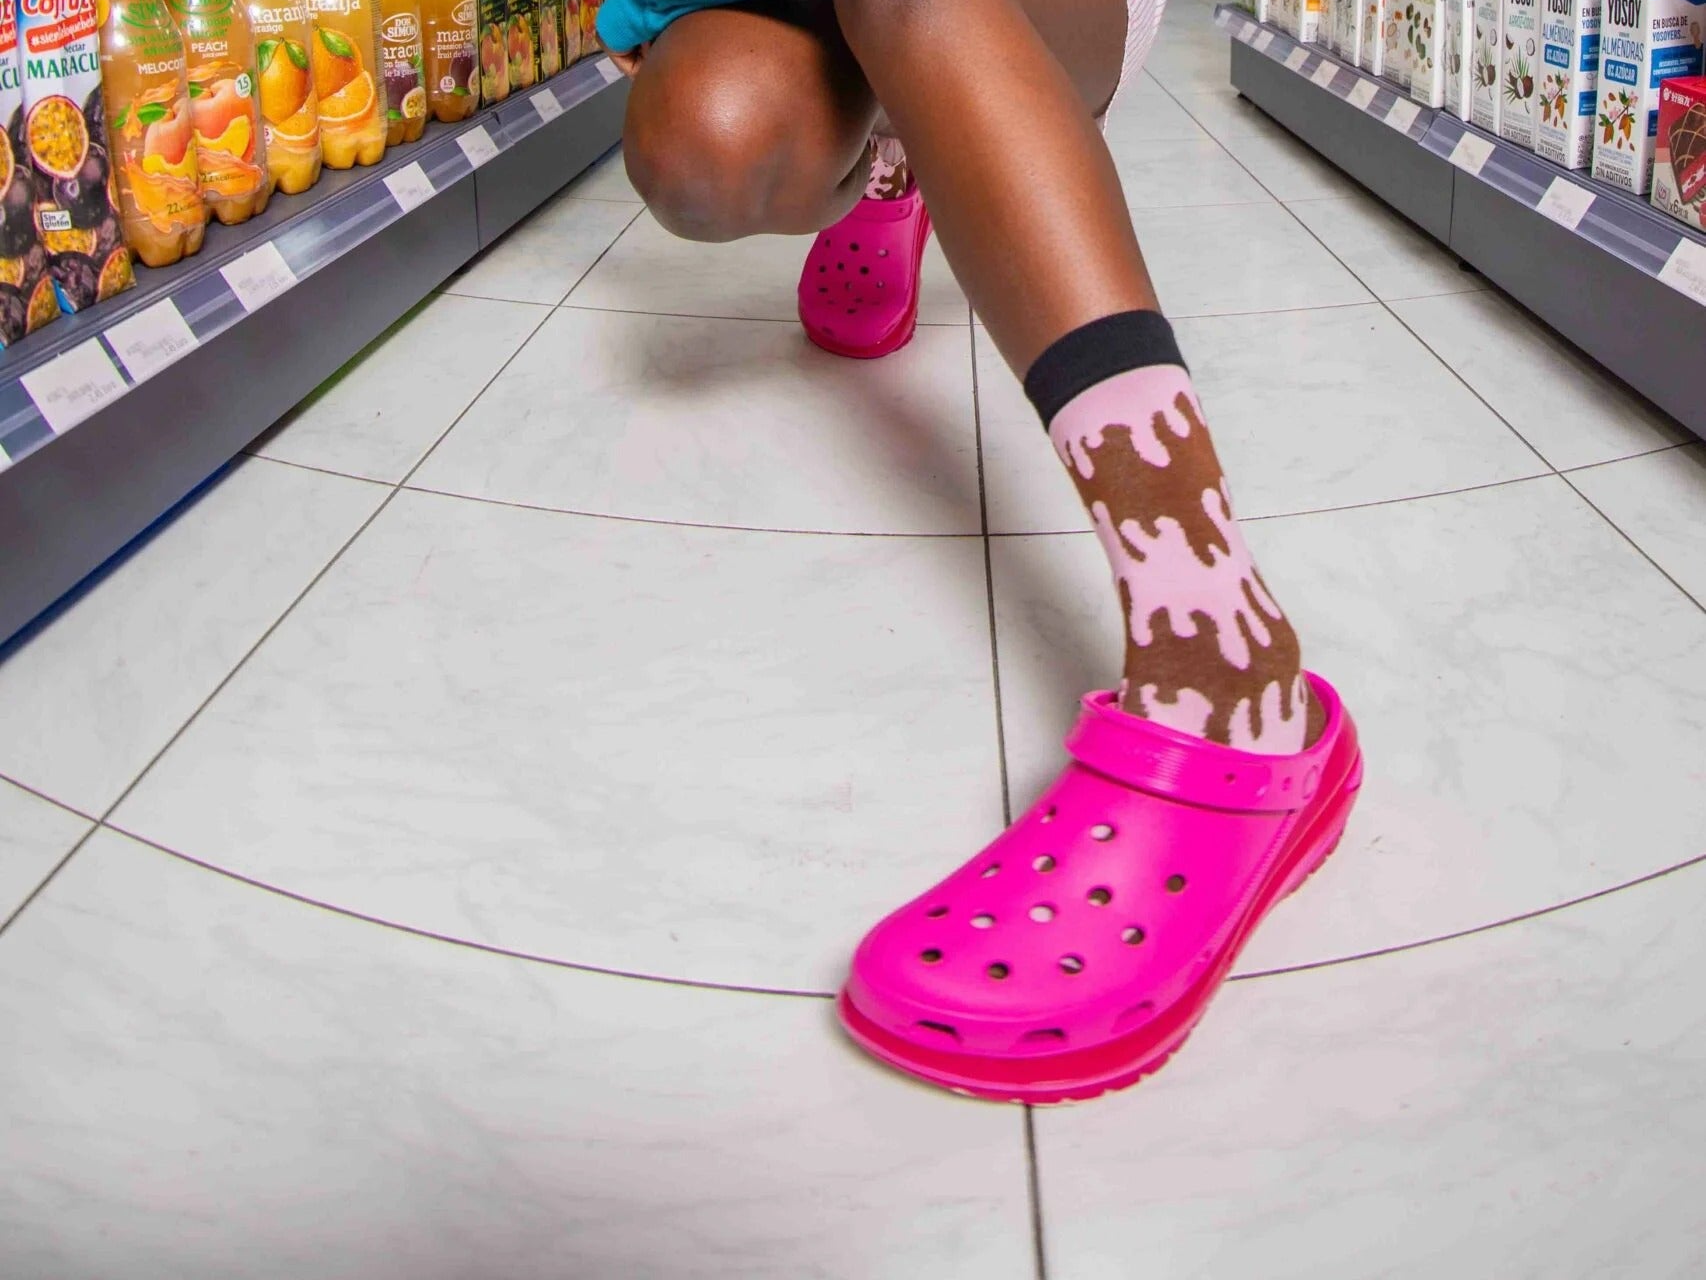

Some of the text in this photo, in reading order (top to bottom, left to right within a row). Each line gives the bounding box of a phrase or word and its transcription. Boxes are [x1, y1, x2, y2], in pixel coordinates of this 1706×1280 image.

[1582, 7, 1591, 18] EN
[395, 18, 412, 27] DON
[1653, 16, 1688, 29] EN BUSCA DE
[387, 26, 416, 38] SIMON
[1543, 22, 1575, 48] ALMENDRAS
[191, 41, 228, 53] PEACH
[437, 43, 462, 51] passion
[1601, 35, 1645, 63] ALMENDRAS
[1615, 63, 1636, 81] AZÚCAR
[1511, 130, 1531, 144] ADITIVOS
[1537, 143, 1565, 163] SIN ADITIVOS
[1595, 167, 1604, 179] SIN
[1605, 171, 1632, 188] ADITIVOS
[166, 203, 180, 215] 22
